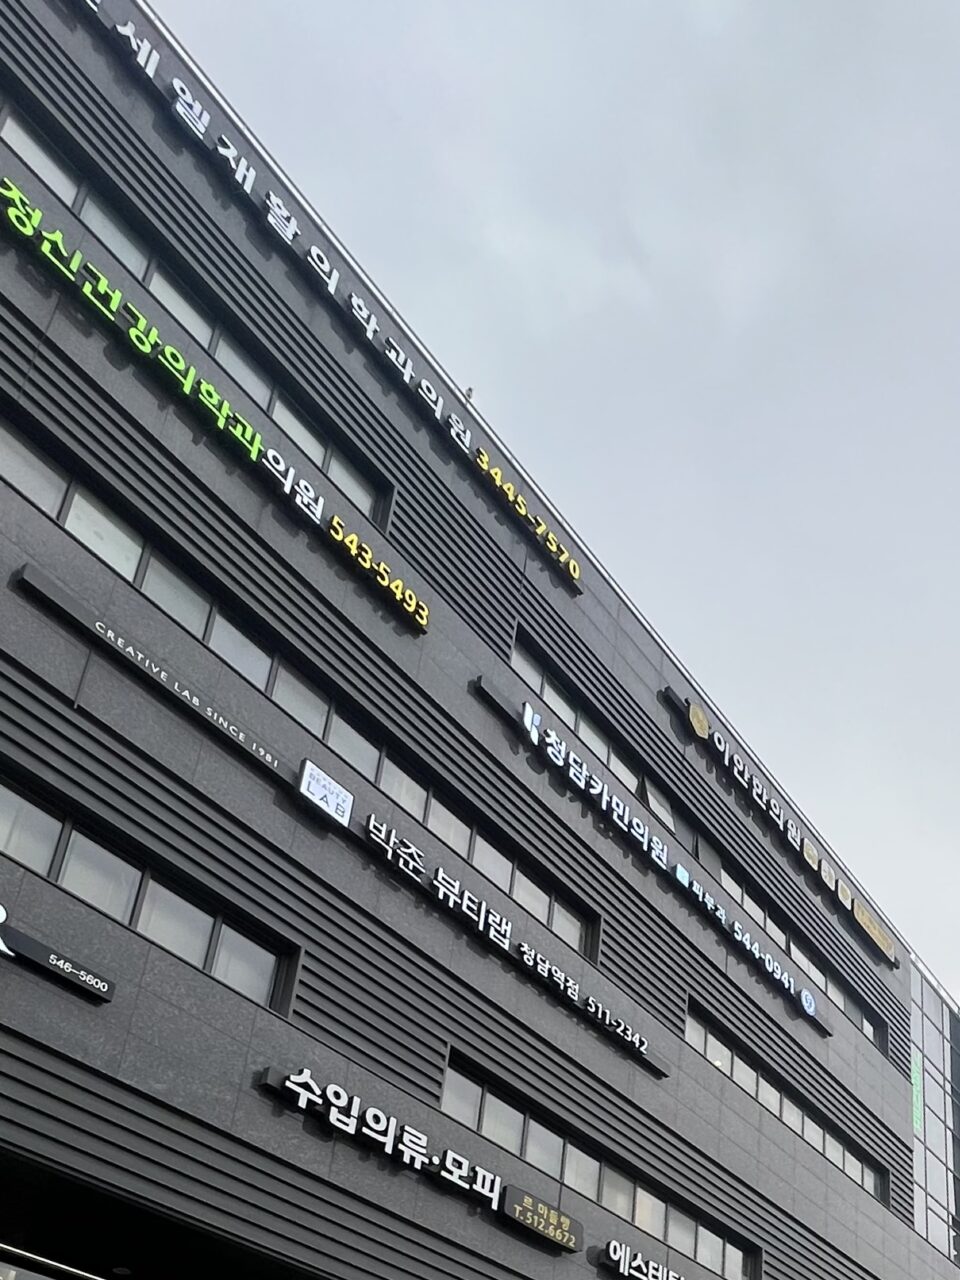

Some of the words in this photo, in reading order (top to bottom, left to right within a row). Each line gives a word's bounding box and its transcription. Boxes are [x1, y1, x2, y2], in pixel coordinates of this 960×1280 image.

[328, 515, 429, 628] 543-5493
[475, 448, 580, 581] 3445-7570
[95, 621, 169, 683] CREATIVE
[174, 681, 200, 707] LAB
[205, 706, 246, 744] SINCE
[251, 742, 279, 769] 1981
[306, 780, 346, 818] LAB
[713, 731, 802, 852] 이안한의원
[543, 728, 669, 870] 청담카민의원
[692, 879, 727, 926] 피부과
[732, 920, 796, 996] 544-0941
[48, 953, 109, 993] 546-5600
[368, 813, 426, 884] 박준
[433, 866, 513, 952] 뷰티랩
[519, 941, 580, 1002] 청담역점
[585, 995, 649, 1055] 511-2342
